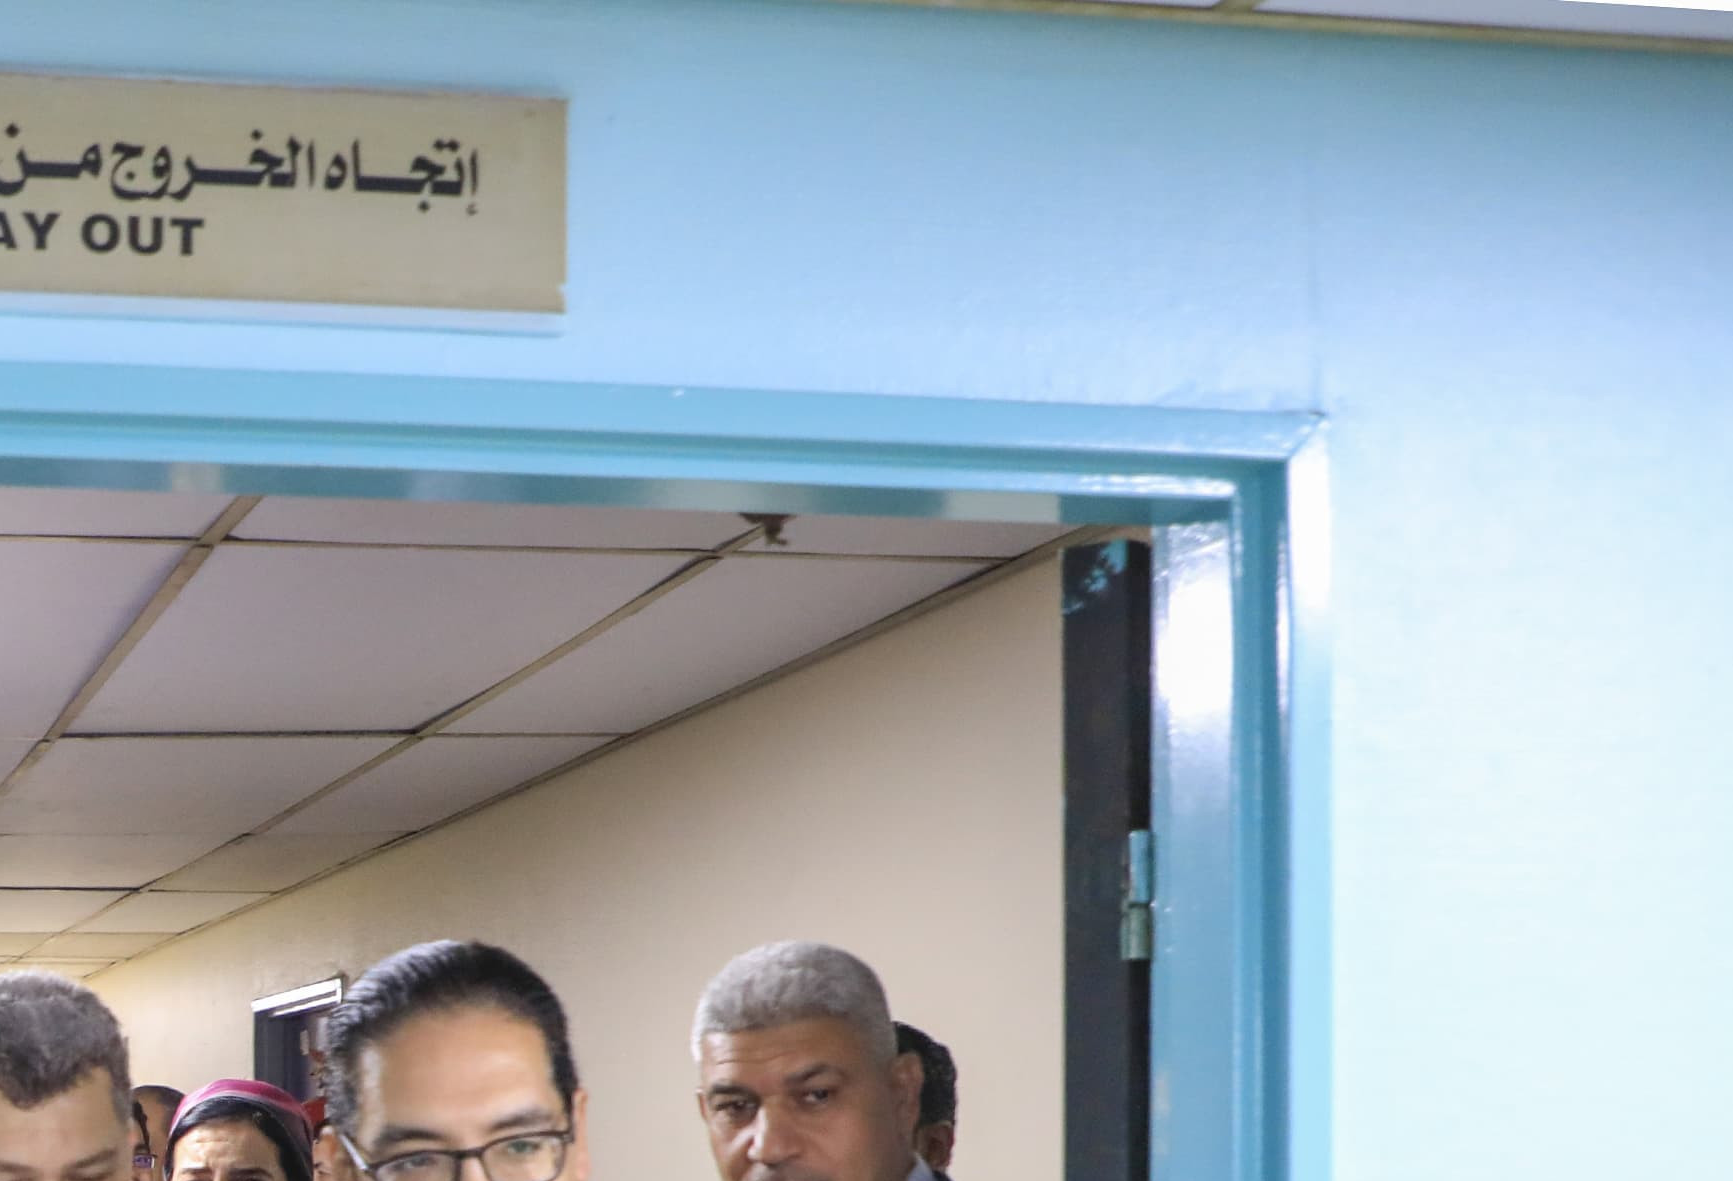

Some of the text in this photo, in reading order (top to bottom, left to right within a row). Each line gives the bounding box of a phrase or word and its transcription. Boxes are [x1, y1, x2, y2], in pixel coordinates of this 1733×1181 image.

[110, 128, 317, 201] الخروج
[323, 137, 479, 216] إتجاه
[80, 212, 205, 256] OUT
